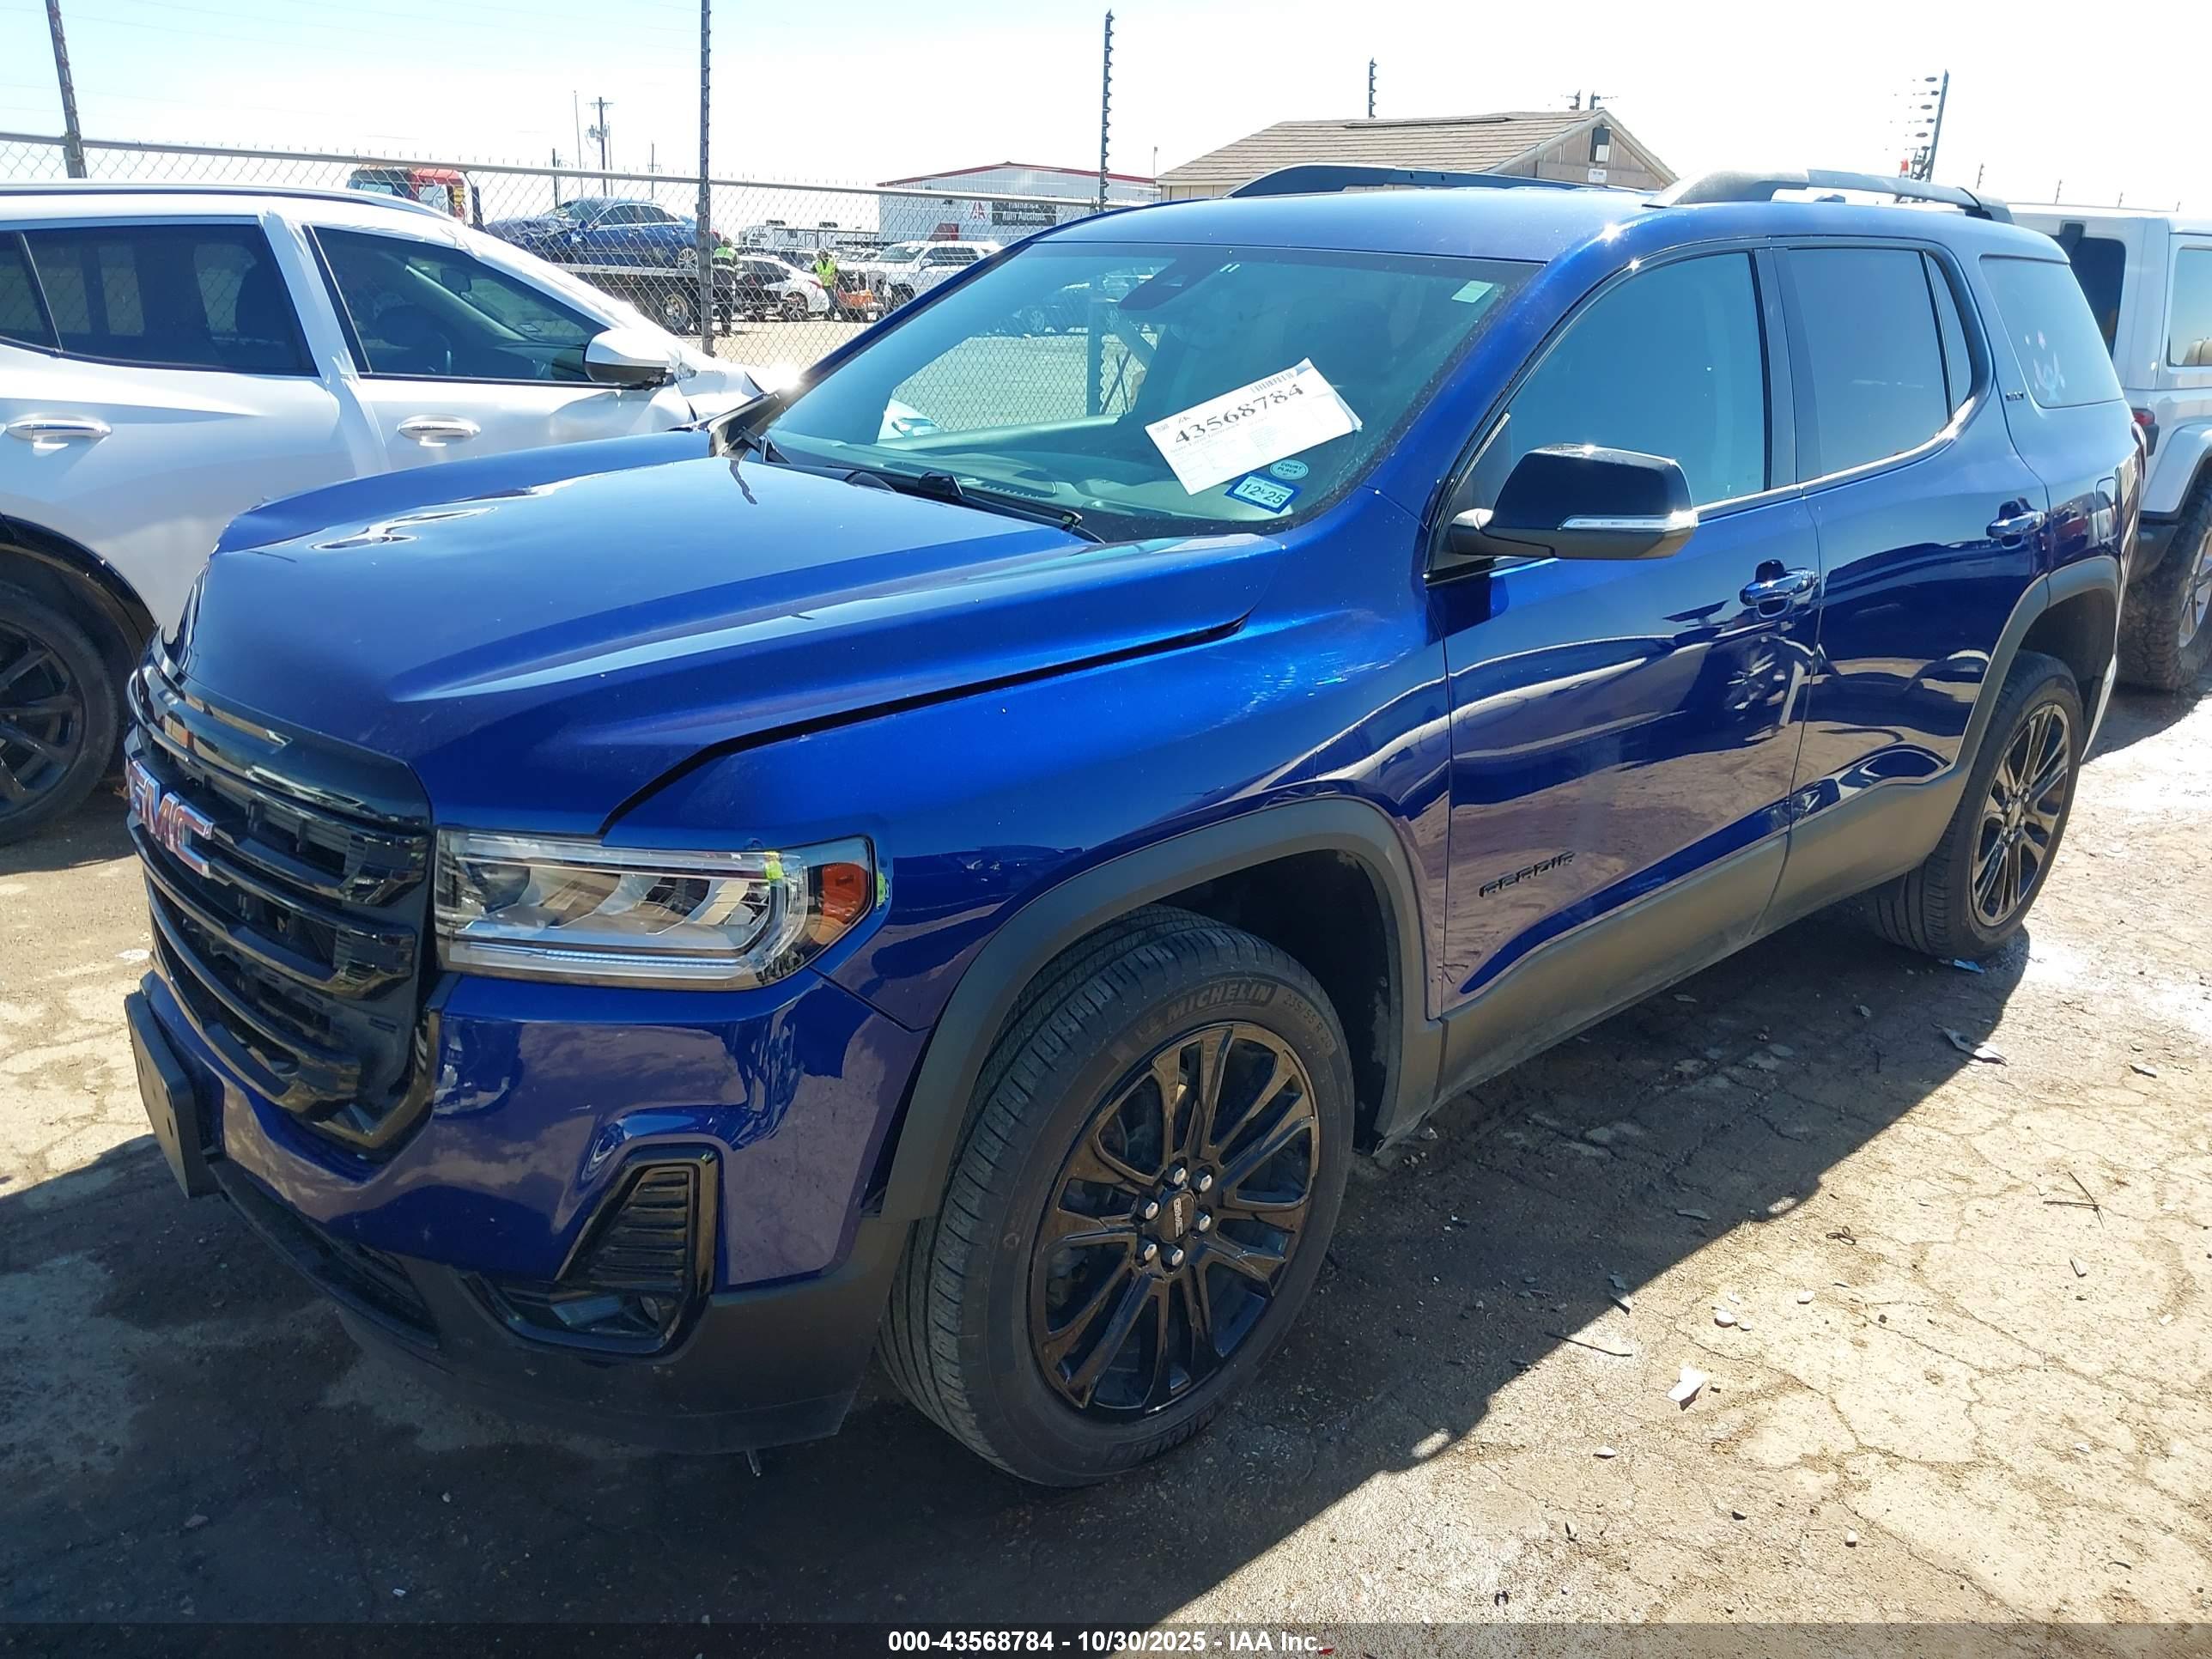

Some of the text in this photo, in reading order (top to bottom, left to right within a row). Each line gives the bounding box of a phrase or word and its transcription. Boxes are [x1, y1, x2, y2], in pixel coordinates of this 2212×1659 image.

[1175, 383, 1304, 444] 43568784
[129, 760, 214, 878] GMC
[1165, 983, 1273, 1024] MICHELIN
[1173, 1197, 1183, 1237] GMC
